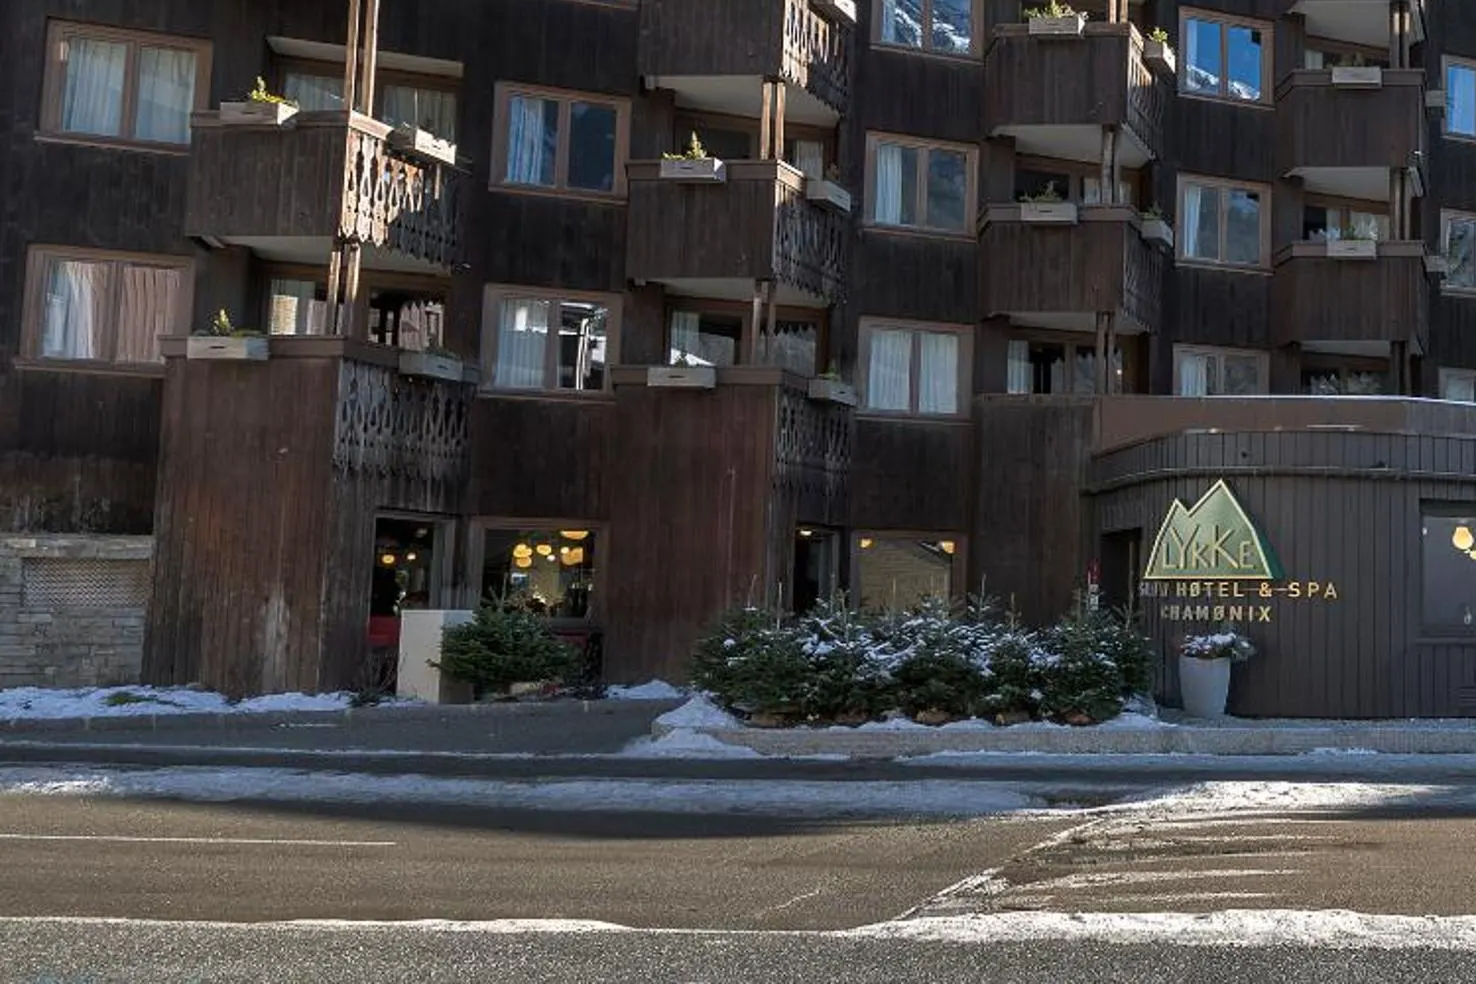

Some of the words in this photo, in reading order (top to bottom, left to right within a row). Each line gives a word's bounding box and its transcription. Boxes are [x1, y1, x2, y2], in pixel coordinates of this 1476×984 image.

[1162, 524, 1256, 569] LYKKE
[1259, 581, 1273, 597] &
[1288, 581, 1338, 599] SPA
